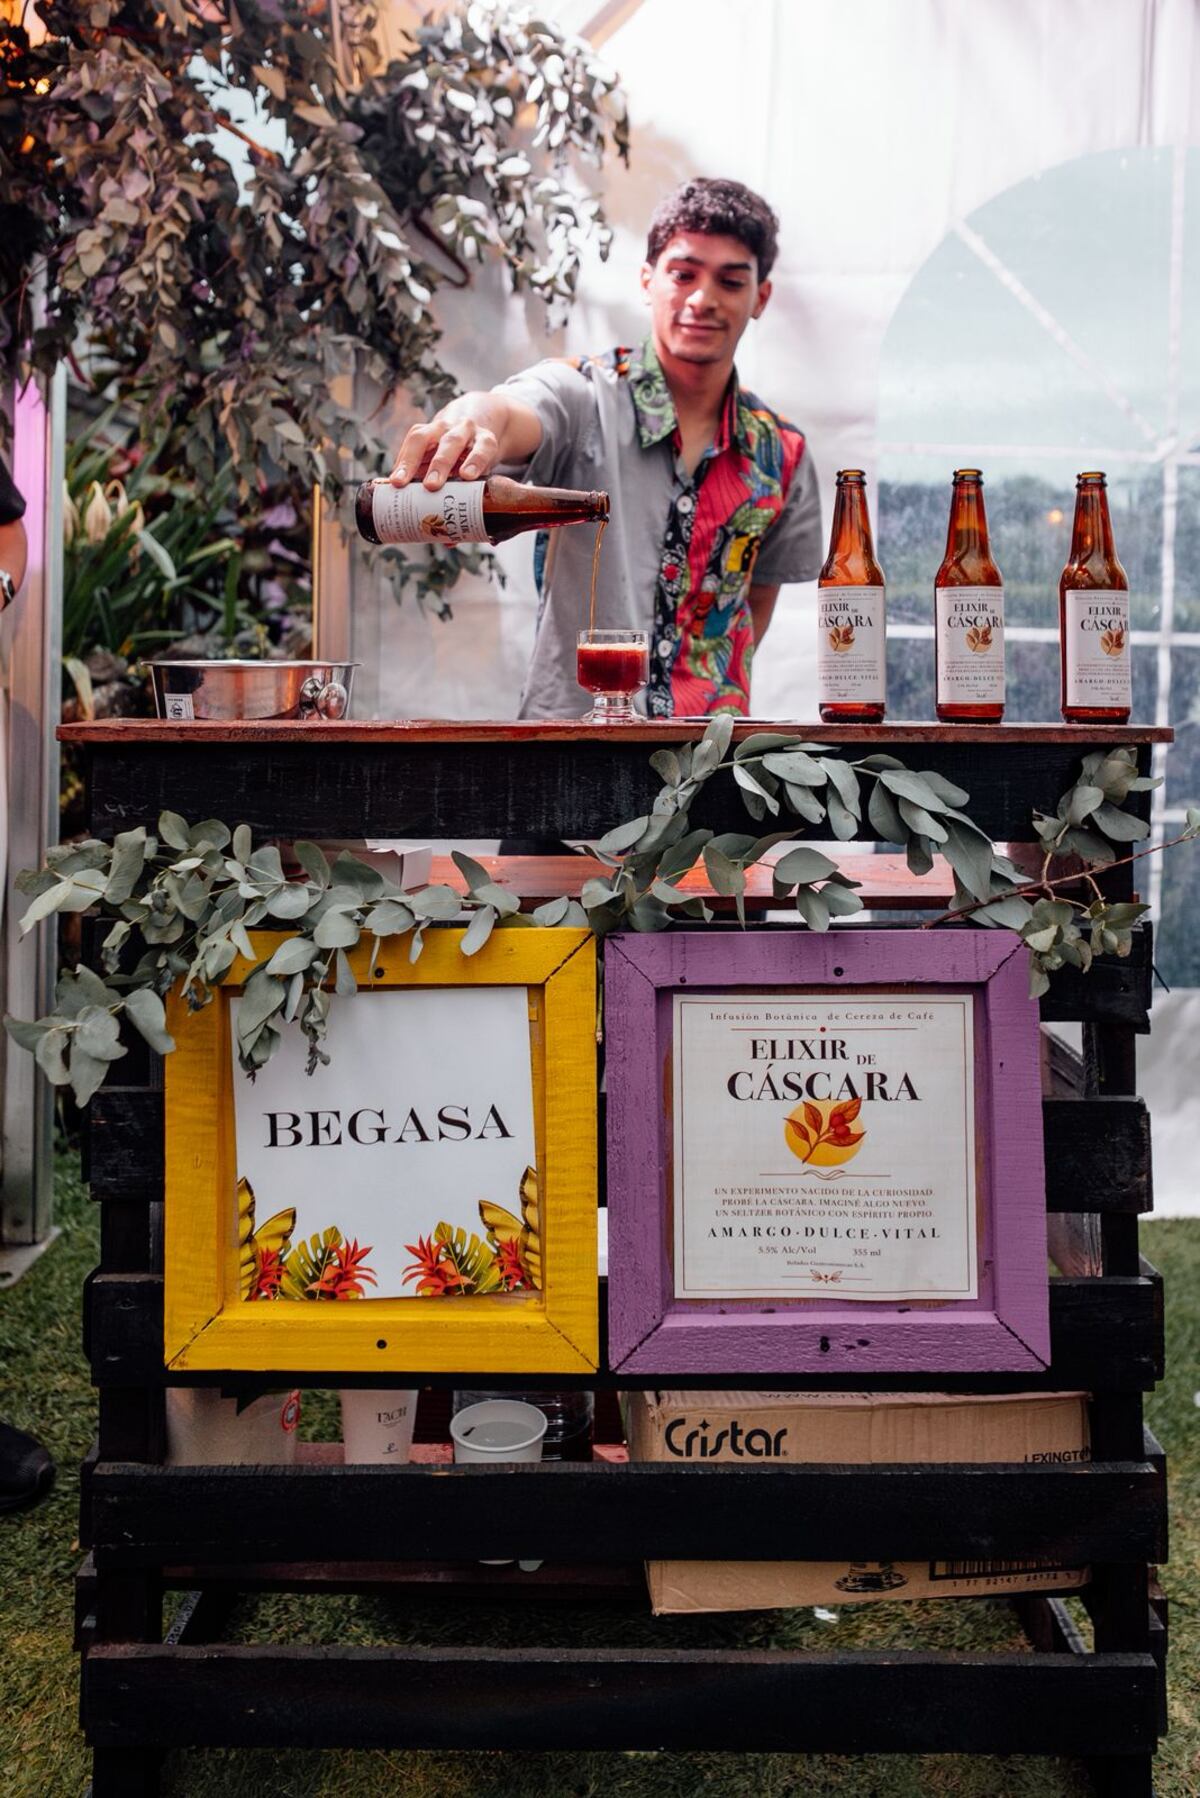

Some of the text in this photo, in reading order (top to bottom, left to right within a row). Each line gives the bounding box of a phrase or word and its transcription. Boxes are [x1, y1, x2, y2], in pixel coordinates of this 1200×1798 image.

[443, 495, 462, 543] CÁSCAR
[954, 603, 988, 612] ELIXIR
[1088, 607, 1121, 615] ELIXIR
[827, 1012, 840, 1021] de
[845, 1012, 884, 1020] Cereza
[889, 1012, 902, 1020] de
[750, 1039, 876, 1065] ELIXIR DE
[727, 1063, 922, 1101] CÁSCARA
[263, 1103, 515, 1148] BEGASA
[714, 1187, 728, 1195] UN
[730, 1187, 799, 1195] EXPERIMENTO
[801, 1187, 839, 1196] NACIDO
[841, 1188, 856, 1196] DE
[857, 1189, 870, 1197] LA
[755, 1198, 768, 1206] LA
[863, 1199, 890, 1208] ALGO
[715, 1209, 729, 1217] UN
[731, 1209, 773, 1217] SELTZER
[775, 1206, 826, 1217] BOTÁNICO
[828, 1210, 849, 1218] CON
[870, 1248, 881, 1256] ml
[664, 1418, 788, 1457] Cristar
